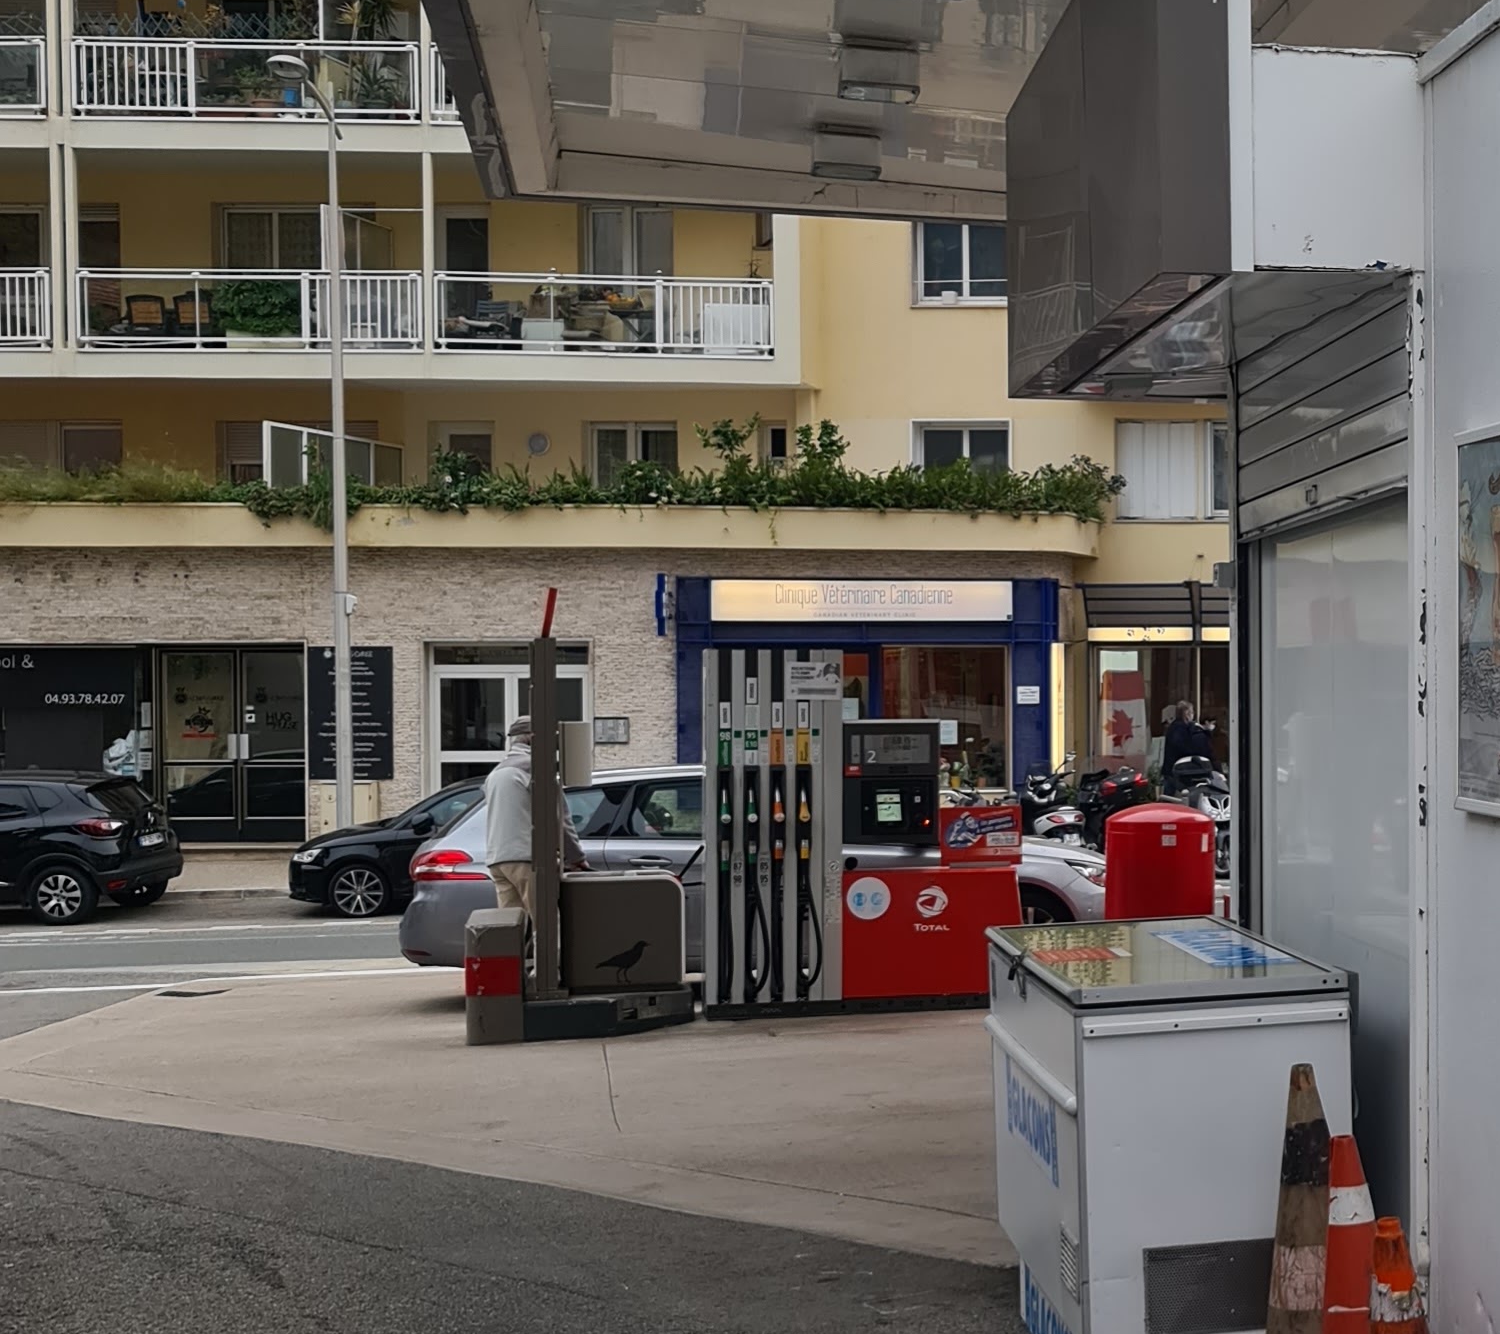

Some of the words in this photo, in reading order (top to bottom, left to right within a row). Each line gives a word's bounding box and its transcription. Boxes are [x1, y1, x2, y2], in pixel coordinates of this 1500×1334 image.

[775, 584, 818, 609] Clinique
[821, 583, 886, 605] Vétérinaire
[890, 583, 953, 605] Canadienne
[44, 693, 126, 705] 04.93.78.42.07
